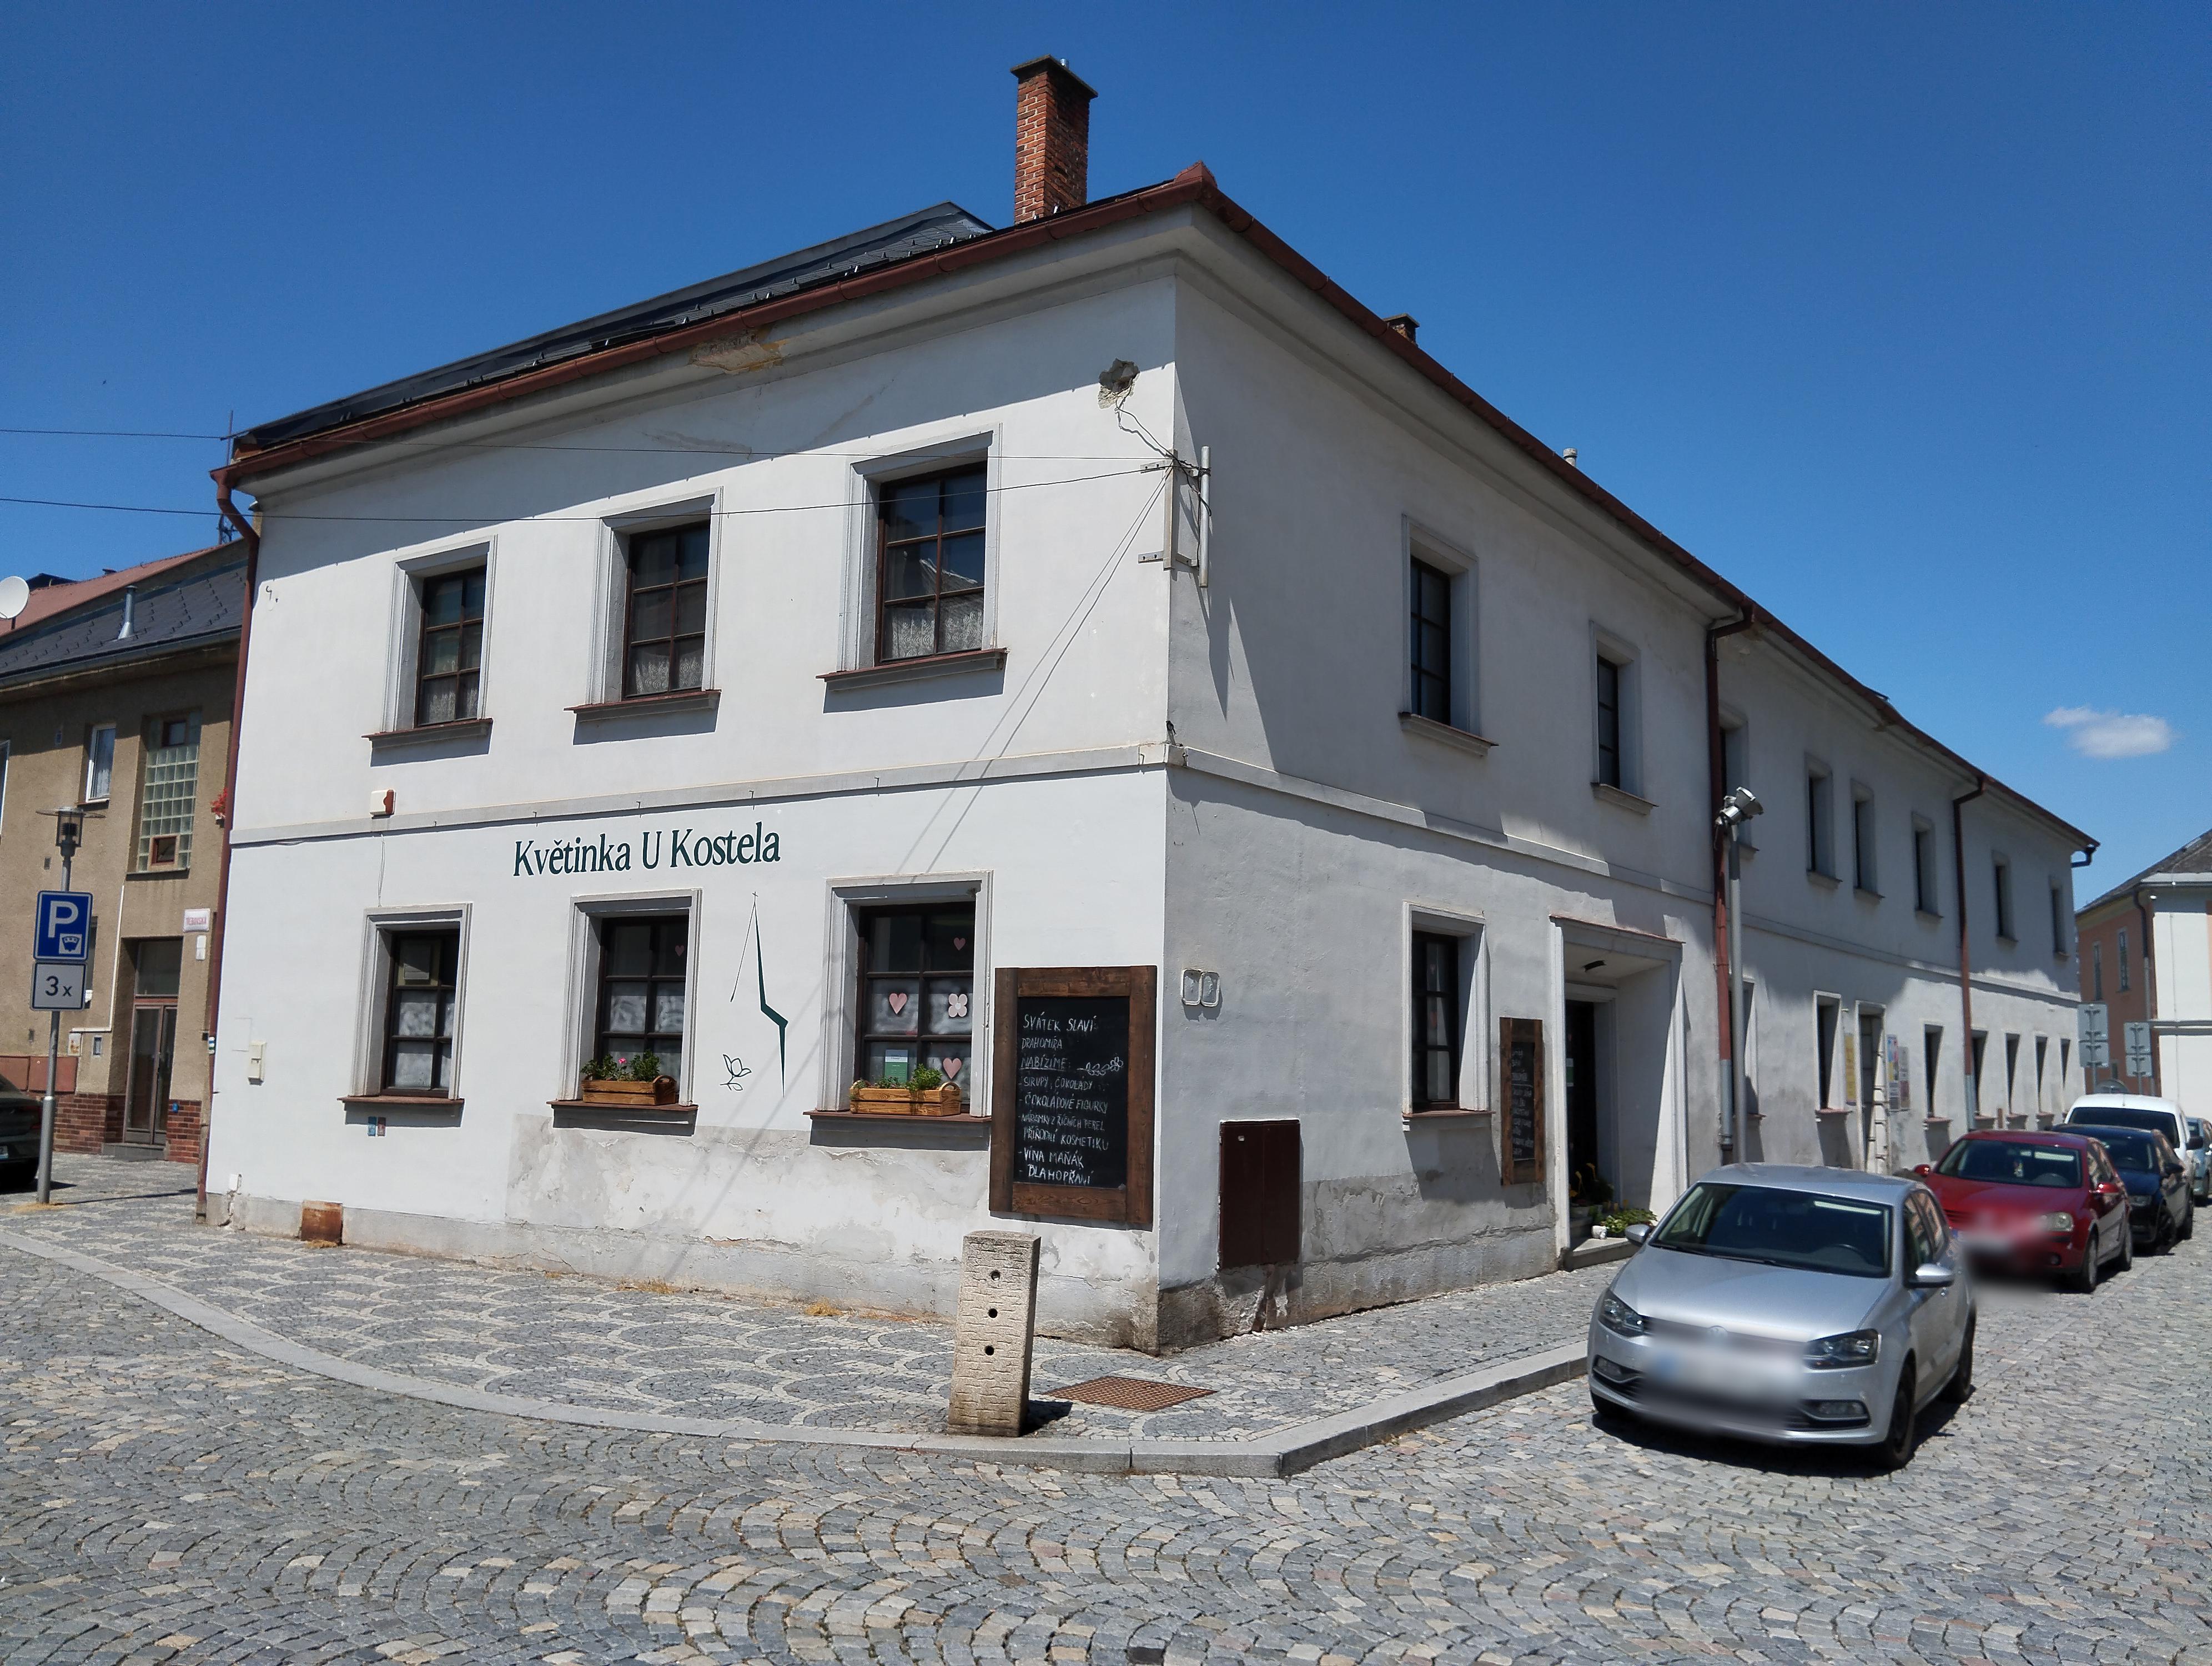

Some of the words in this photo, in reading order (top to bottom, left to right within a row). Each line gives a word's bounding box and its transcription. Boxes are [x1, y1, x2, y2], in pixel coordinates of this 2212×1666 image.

[513, 834, 631, 876] Květinka
[642, 831, 662, 869] U
[670, 821, 781, 867] Kostela
[48, 900, 78, 938] P
[1023, 1012, 1061, 1031] SVÁTEK
[1055, 1076, 1093, 1091] ČOKOLÁDY
[1024, 1091, 1075, 1109] ČOKOLÁDOVÉ
[1076, 1099, 1107, 1114] FIGURKY
[1084, 1119, 1105, 1131] PEREL
[1061, 1135, 1109, 1151] KOSMETIKU
[1024, 1146, 1045, 1162] VÍNA
